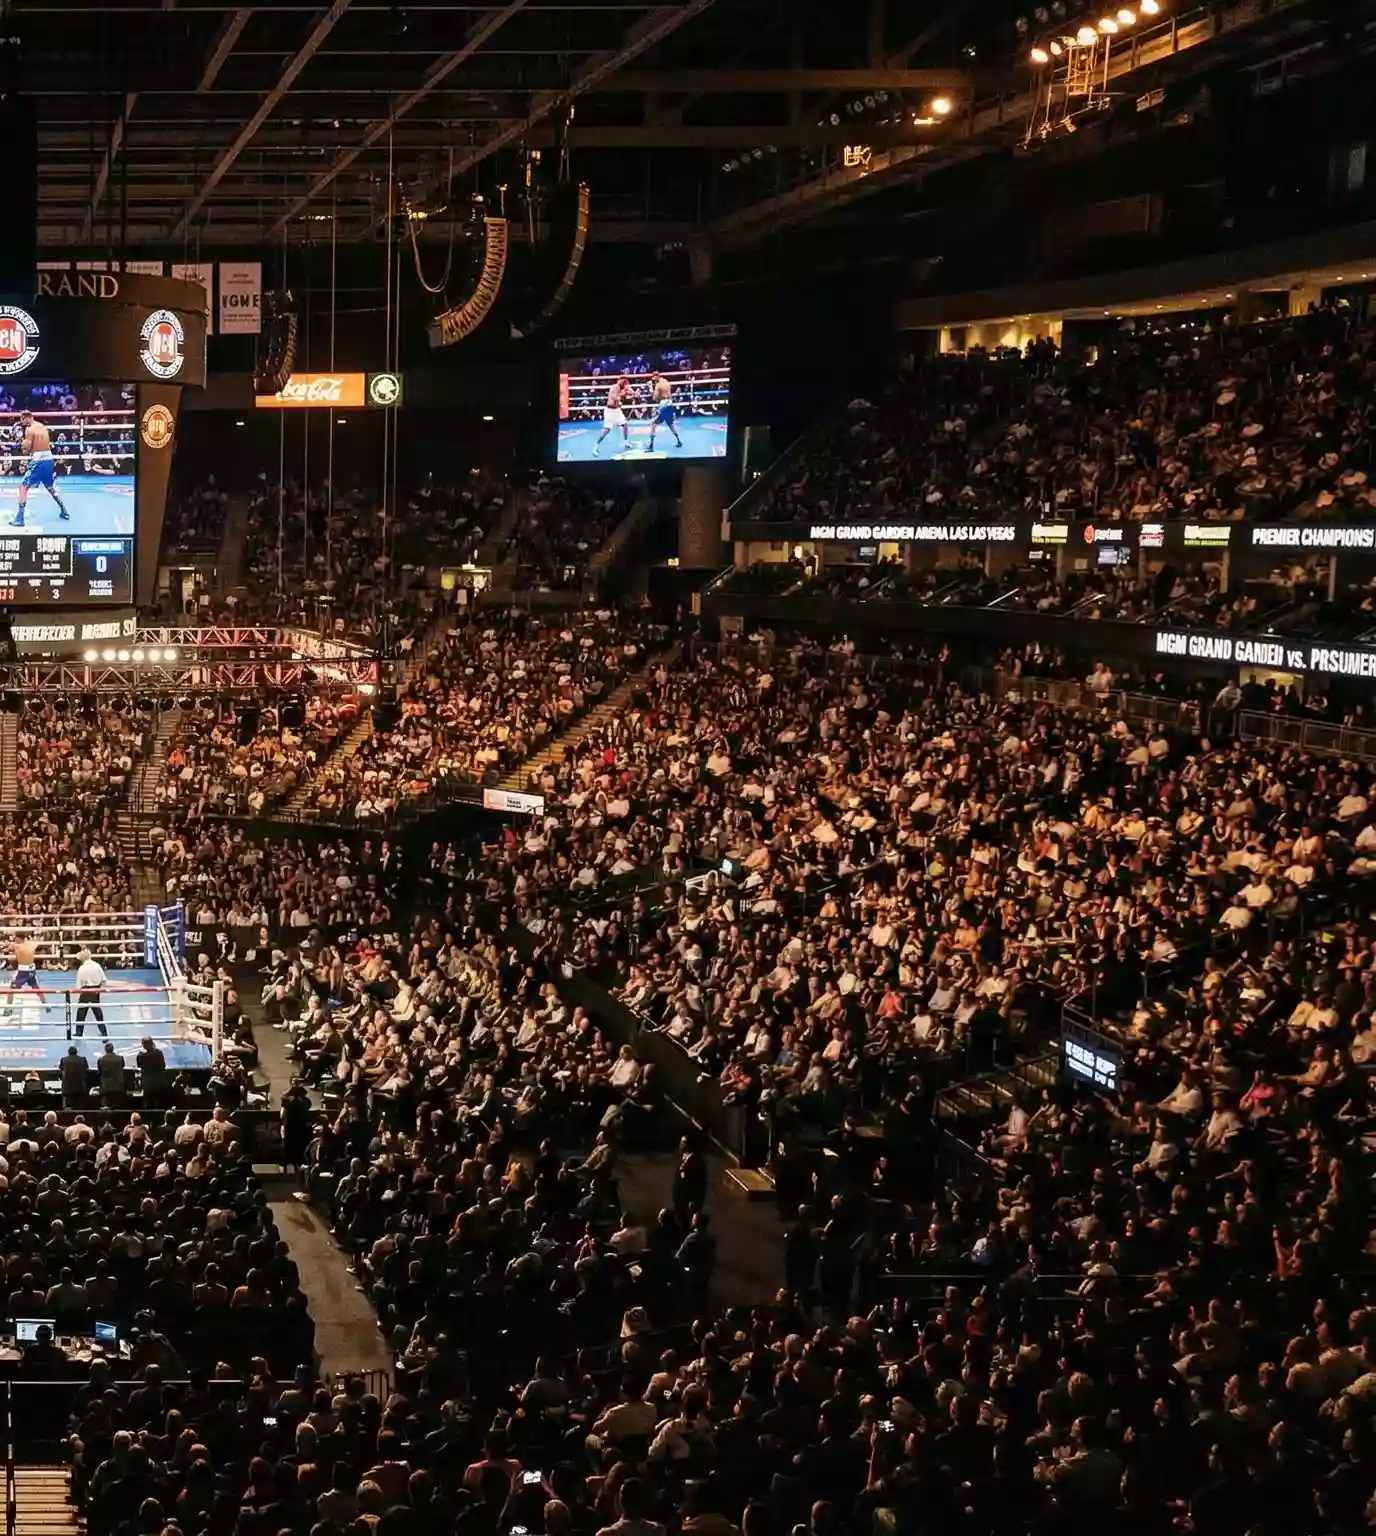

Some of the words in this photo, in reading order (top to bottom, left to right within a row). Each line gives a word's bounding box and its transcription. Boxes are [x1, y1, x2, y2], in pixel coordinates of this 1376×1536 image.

[949, 526, 969, 541] LAS
[968, 526, 987, 541] LAS
[1156, 632, 1187, 655] MGM
[1189, 635, 1232, 660] GRAND
